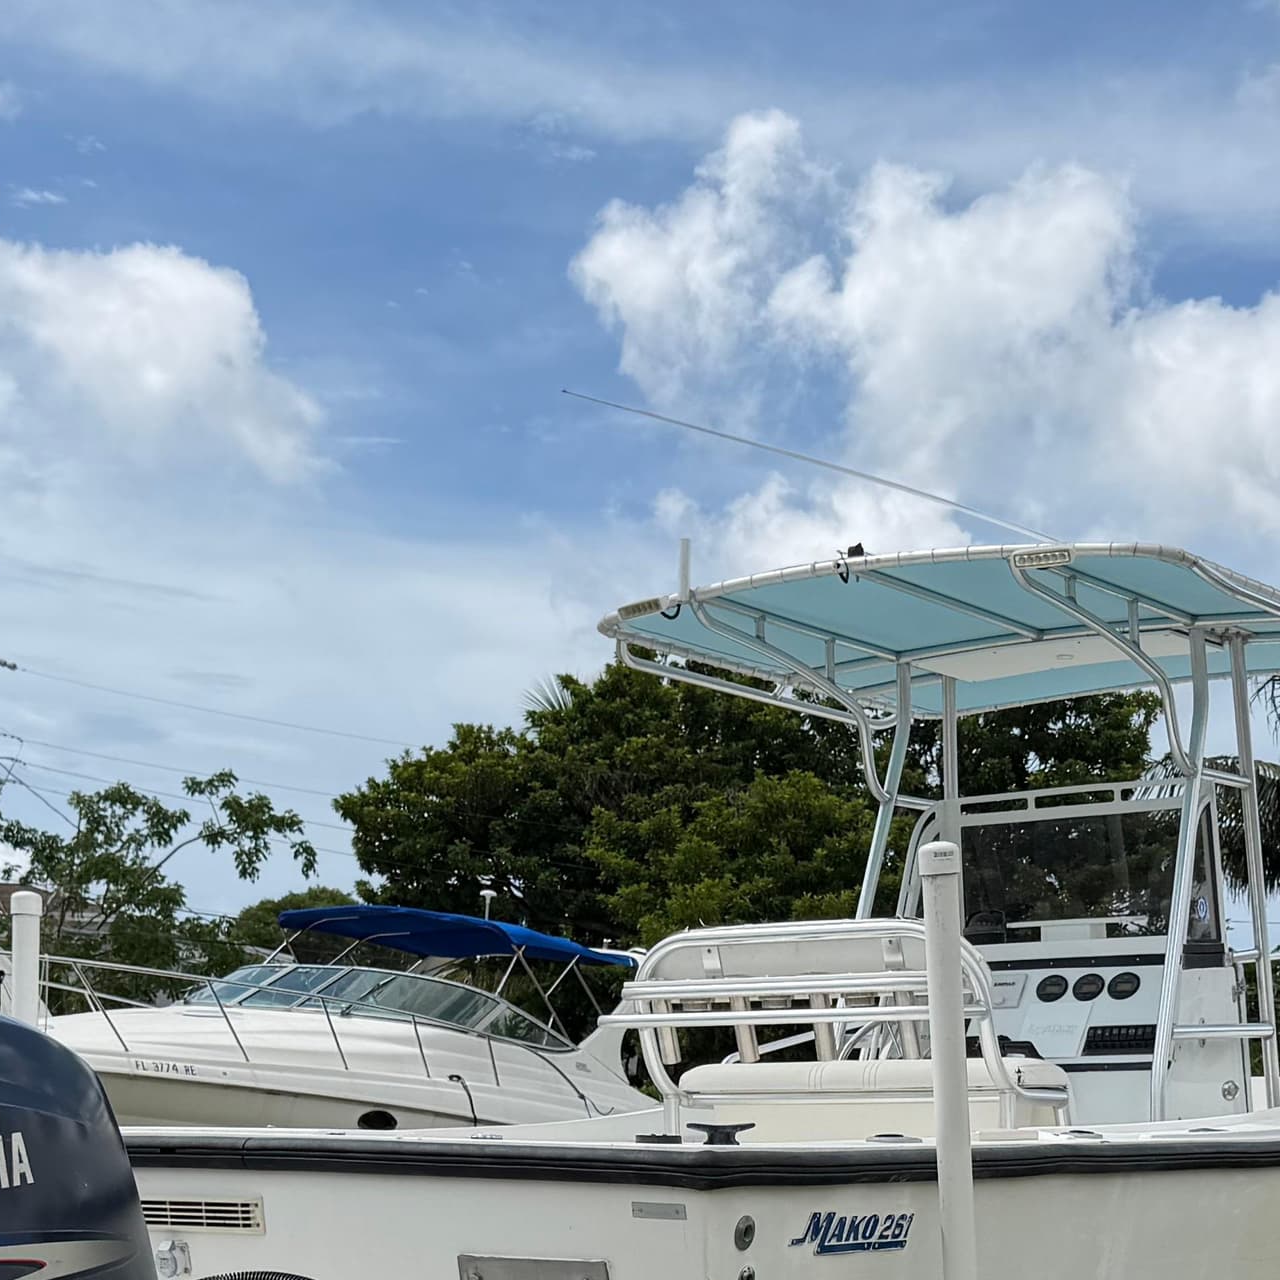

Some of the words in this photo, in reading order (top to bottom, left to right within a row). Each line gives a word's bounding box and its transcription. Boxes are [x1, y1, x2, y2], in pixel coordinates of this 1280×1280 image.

[135, 1060, 148, 1071] FL
[152, 1062, 179, 1074] 3774
[788, 1211, 880, 1256] MAKO
[878, 1213, 915, 1240] 261
